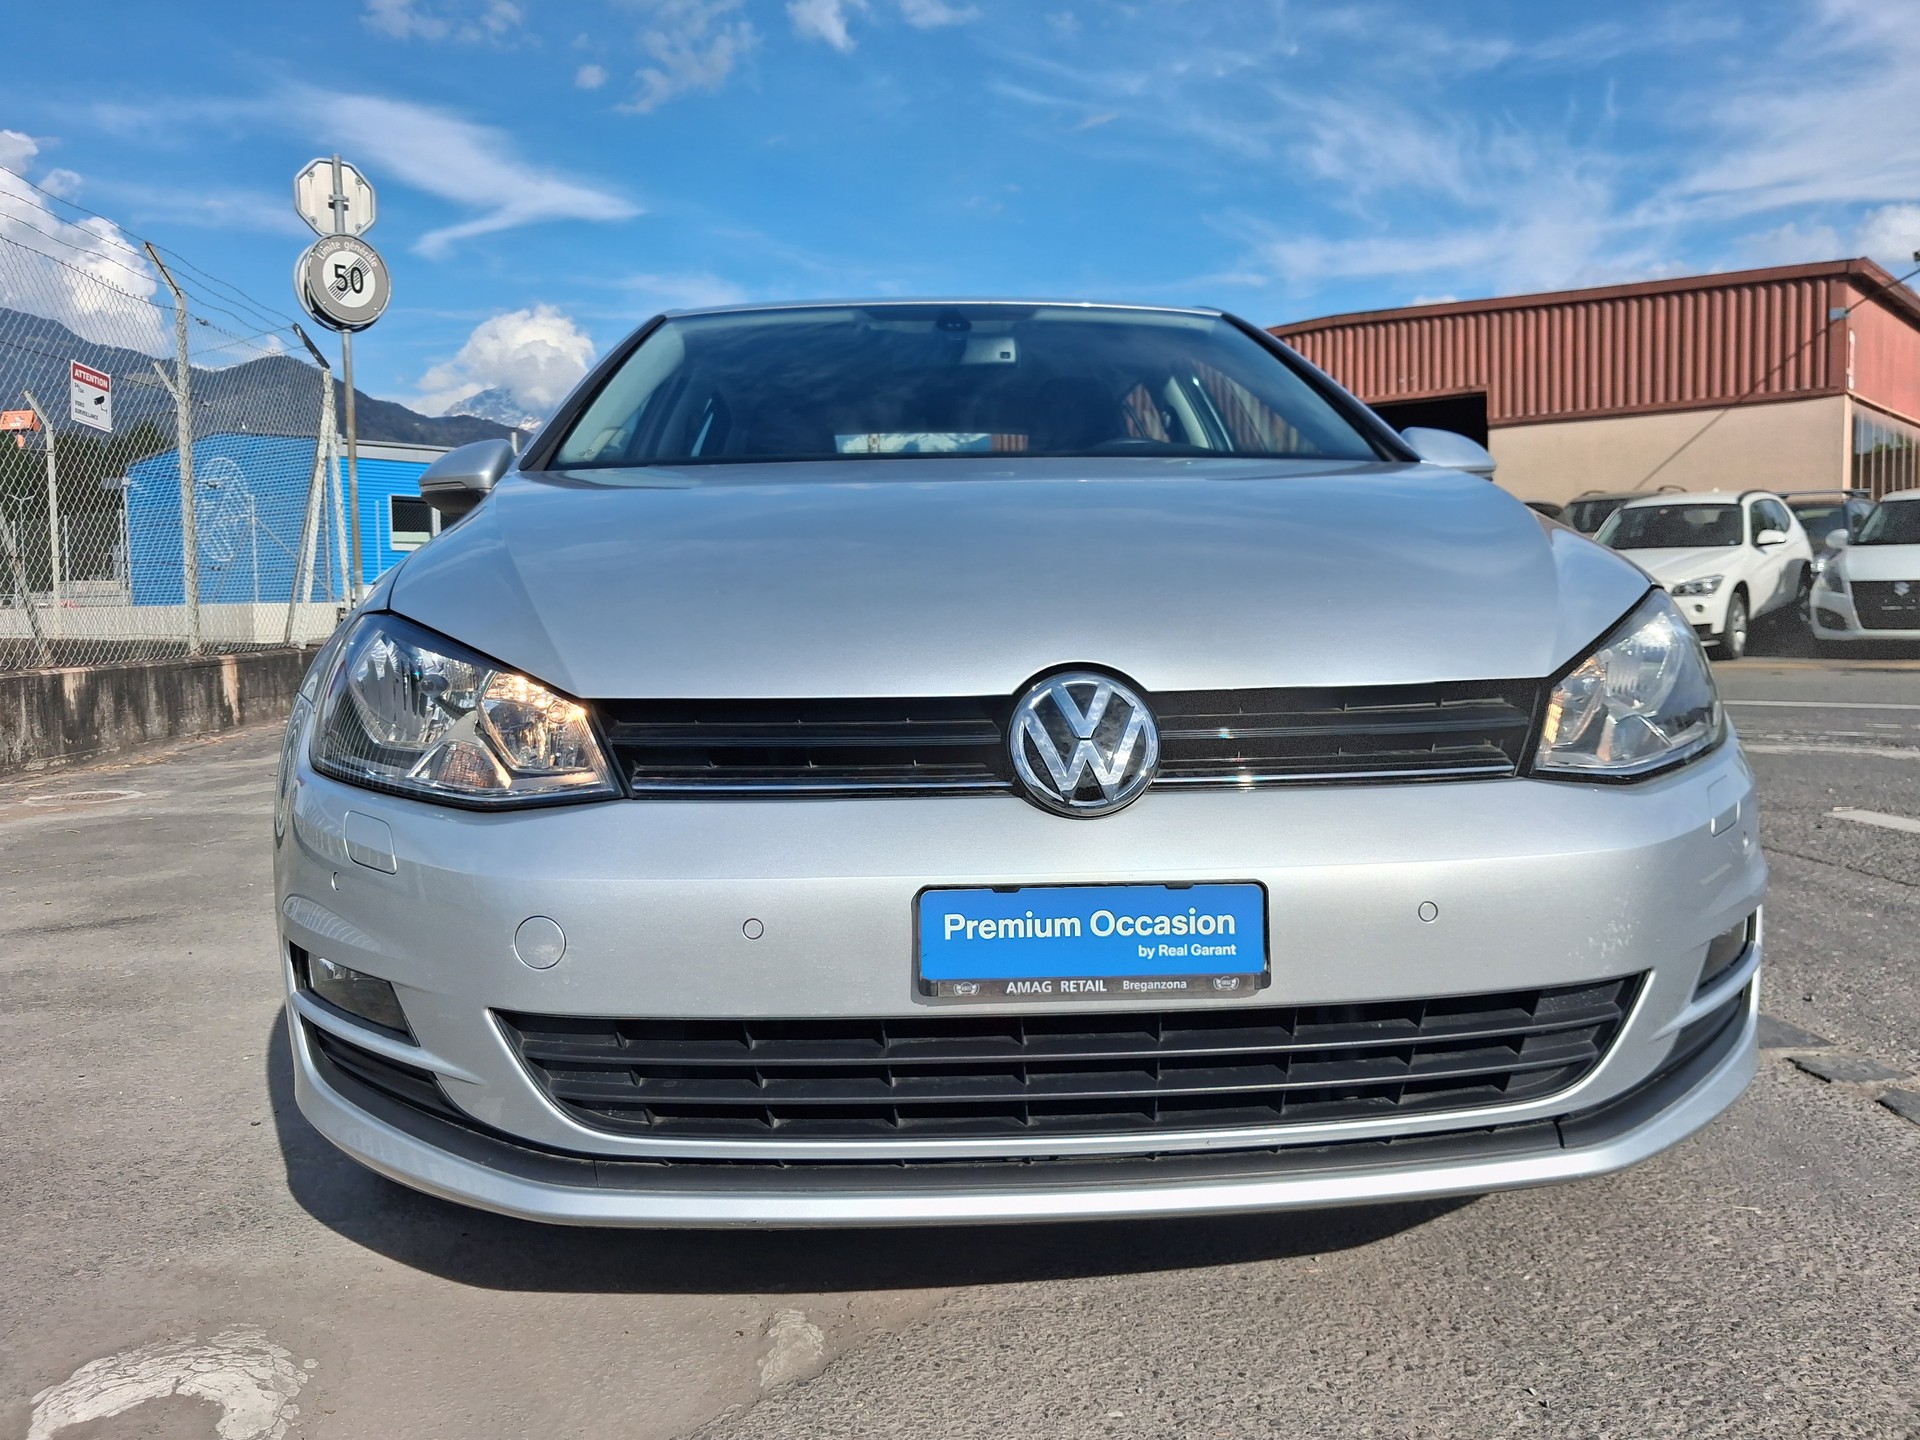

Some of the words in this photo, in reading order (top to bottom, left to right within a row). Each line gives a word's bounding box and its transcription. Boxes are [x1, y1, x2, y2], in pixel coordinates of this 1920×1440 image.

[316, 241, 341, 260] Limite
[334, 264, 364, 294] 50
[74, 368, 109, 389] ATTENTION
[944, 910, 1081, 940] Premium
[1089, 907, 1236, 937] Occasion
[1138, 944, 1155, 959] by
[1158, 944, 1188, 957] Real
[1190, 943, 1237, 956] Garant
[1006, 980, 1052, 994] AMAG
[1060, 979, 1107, 993] RETAIL
[1122, 980, 1187, 992] Breganzona
